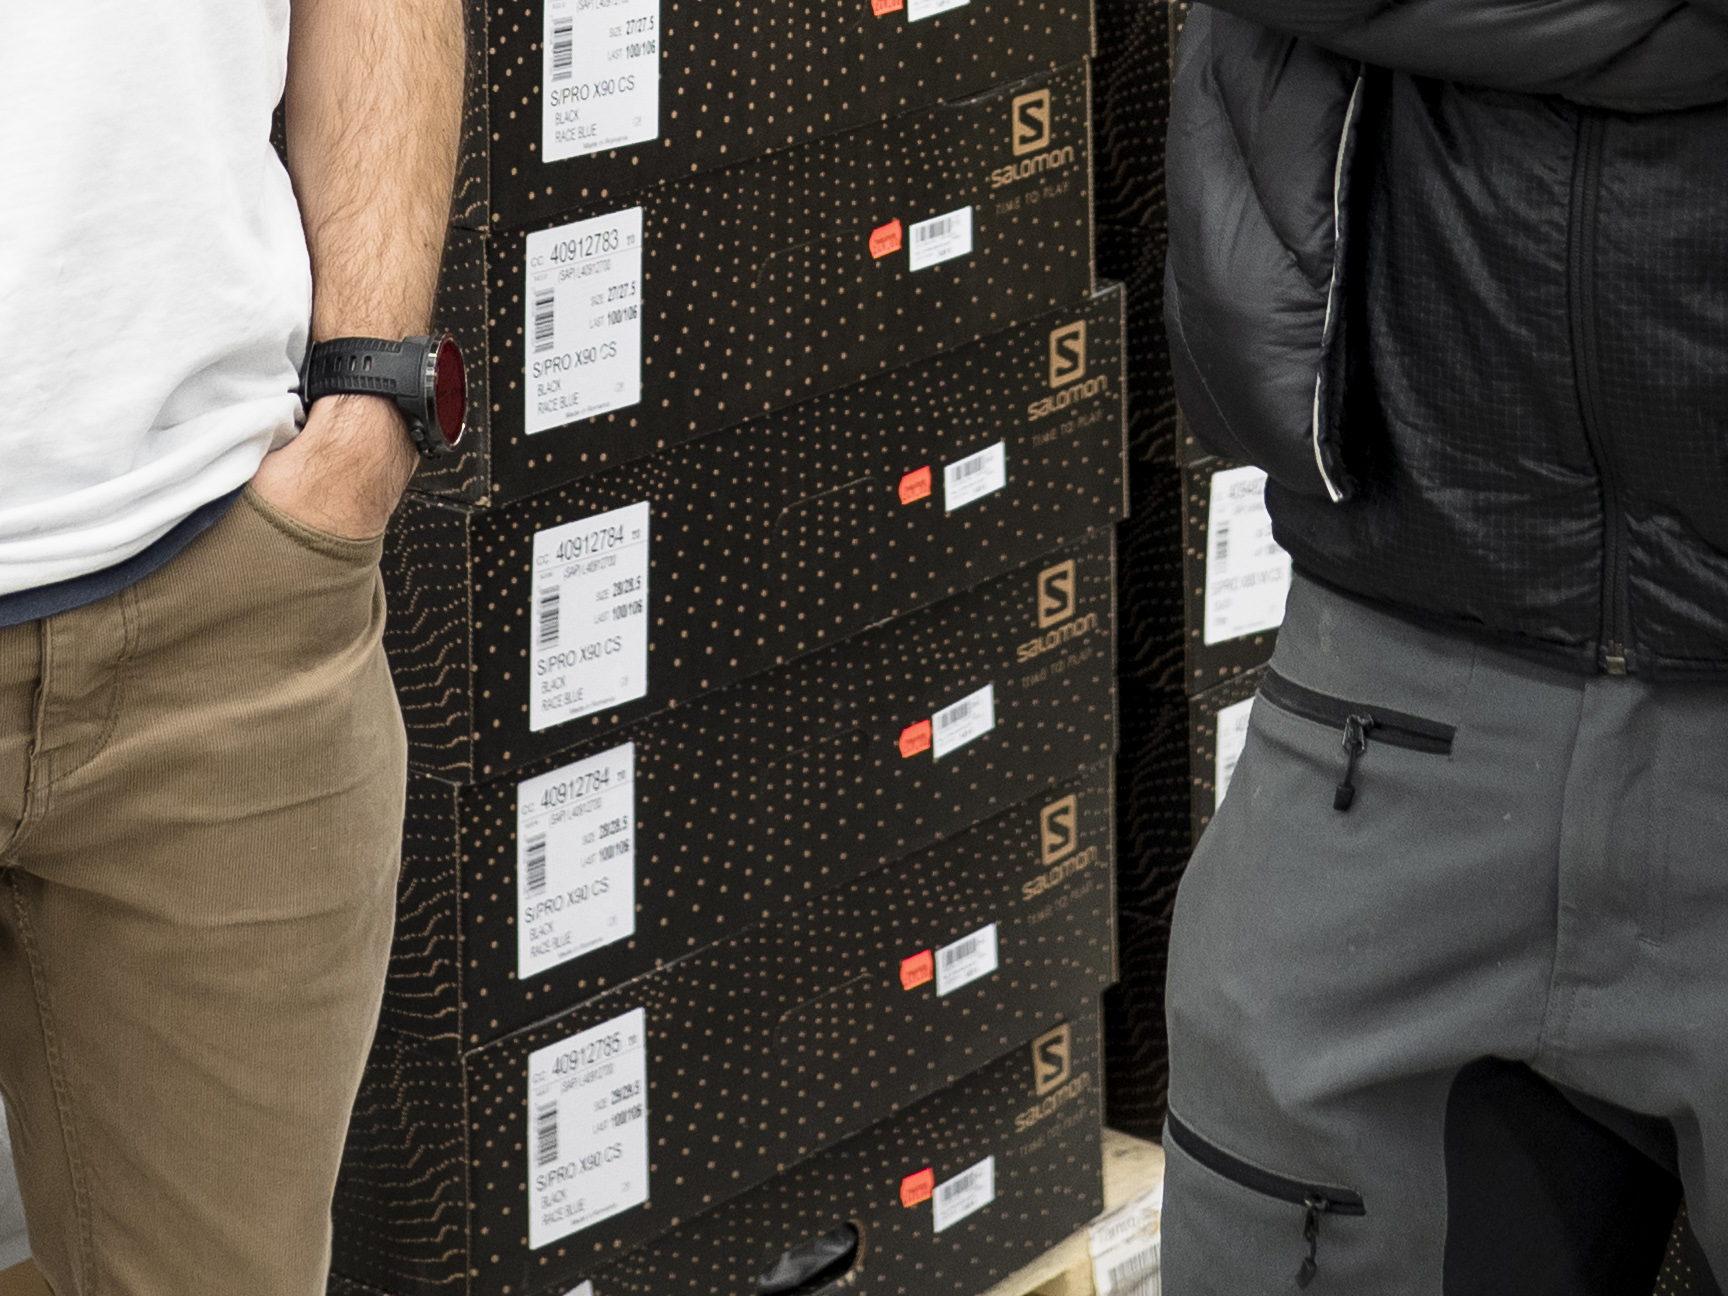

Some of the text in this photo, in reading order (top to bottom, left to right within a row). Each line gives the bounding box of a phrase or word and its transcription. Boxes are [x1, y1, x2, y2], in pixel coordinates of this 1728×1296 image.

[626, 16, 654, 35] 27/27.5
[550, 75, 635, 107] S/PRO X90 CS
[555, 109, 579, 125] BLACK
[550, 229, 619, 264] 40912783
[533, 341, 617, 379] S/PRO X90 CS
[556, 525, 624, 561] 40912784
